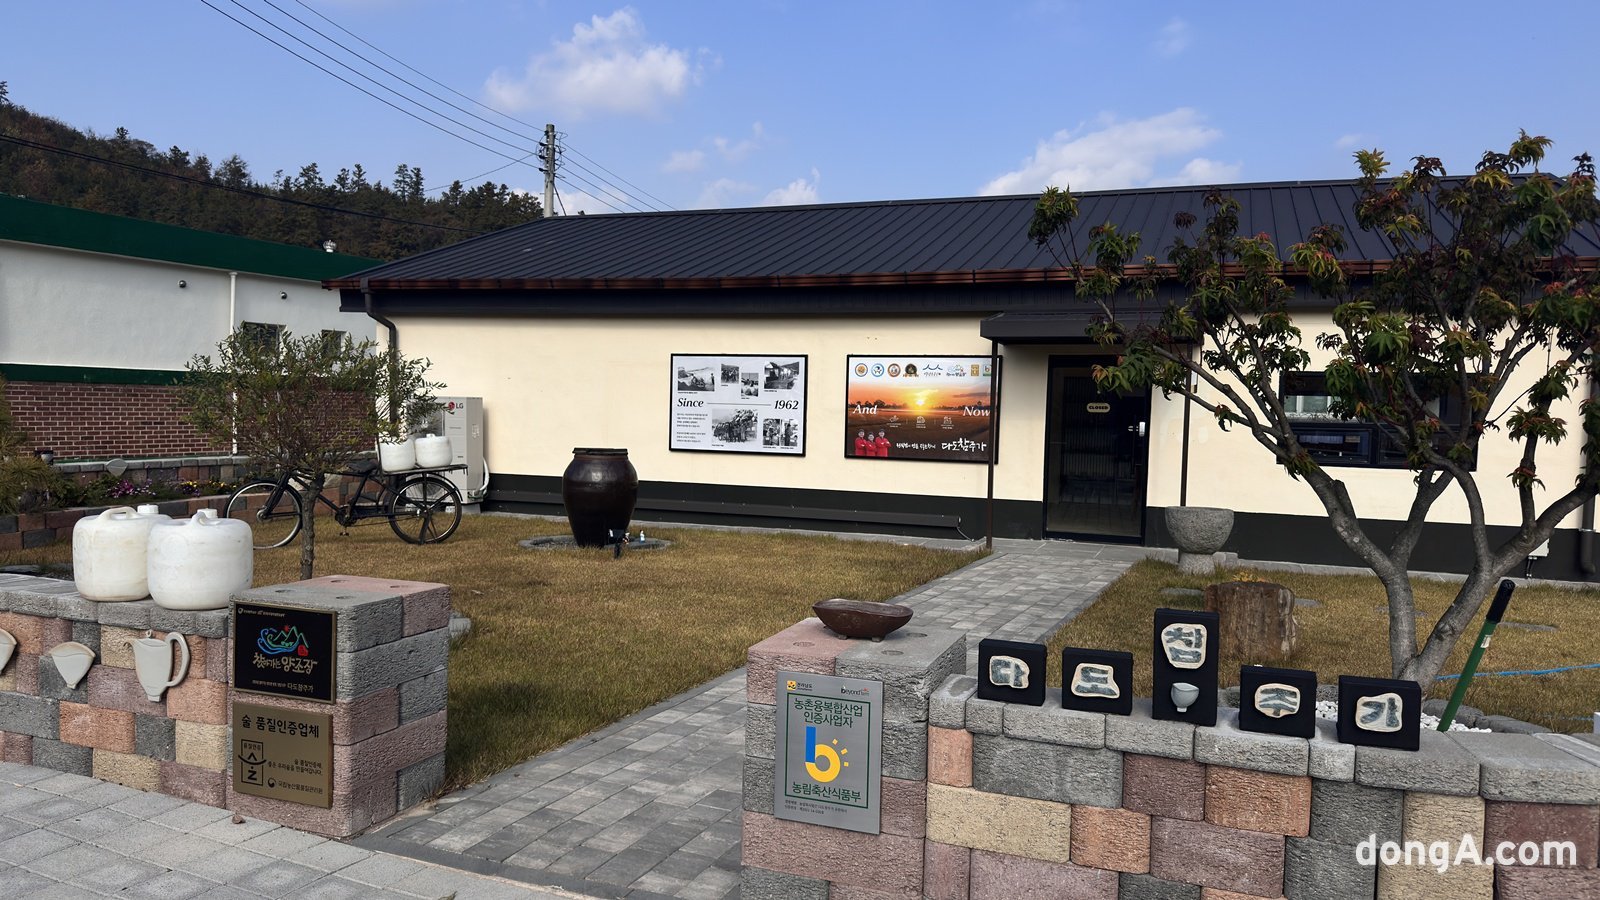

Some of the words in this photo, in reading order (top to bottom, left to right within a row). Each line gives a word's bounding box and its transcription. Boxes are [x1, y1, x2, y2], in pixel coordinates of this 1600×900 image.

[677, 398, 704, 408] Since
[774, 400, 799, 410] 1962
[852, 405, 877, 415] And
[963, 406, 990, 417] Now
[941, 438, 987, 453] 다도참주가
[281, 656, 318, 675] 양조장
[794, 697, 863, 717] 농촌융복합산업
[241, 714, 251, 729] 술
[256, 716, 319, 738] 품질인증업체
[804, 711, 854, 728] 인증사업자
[792, 781, 861, 803] 농림축산식품부
